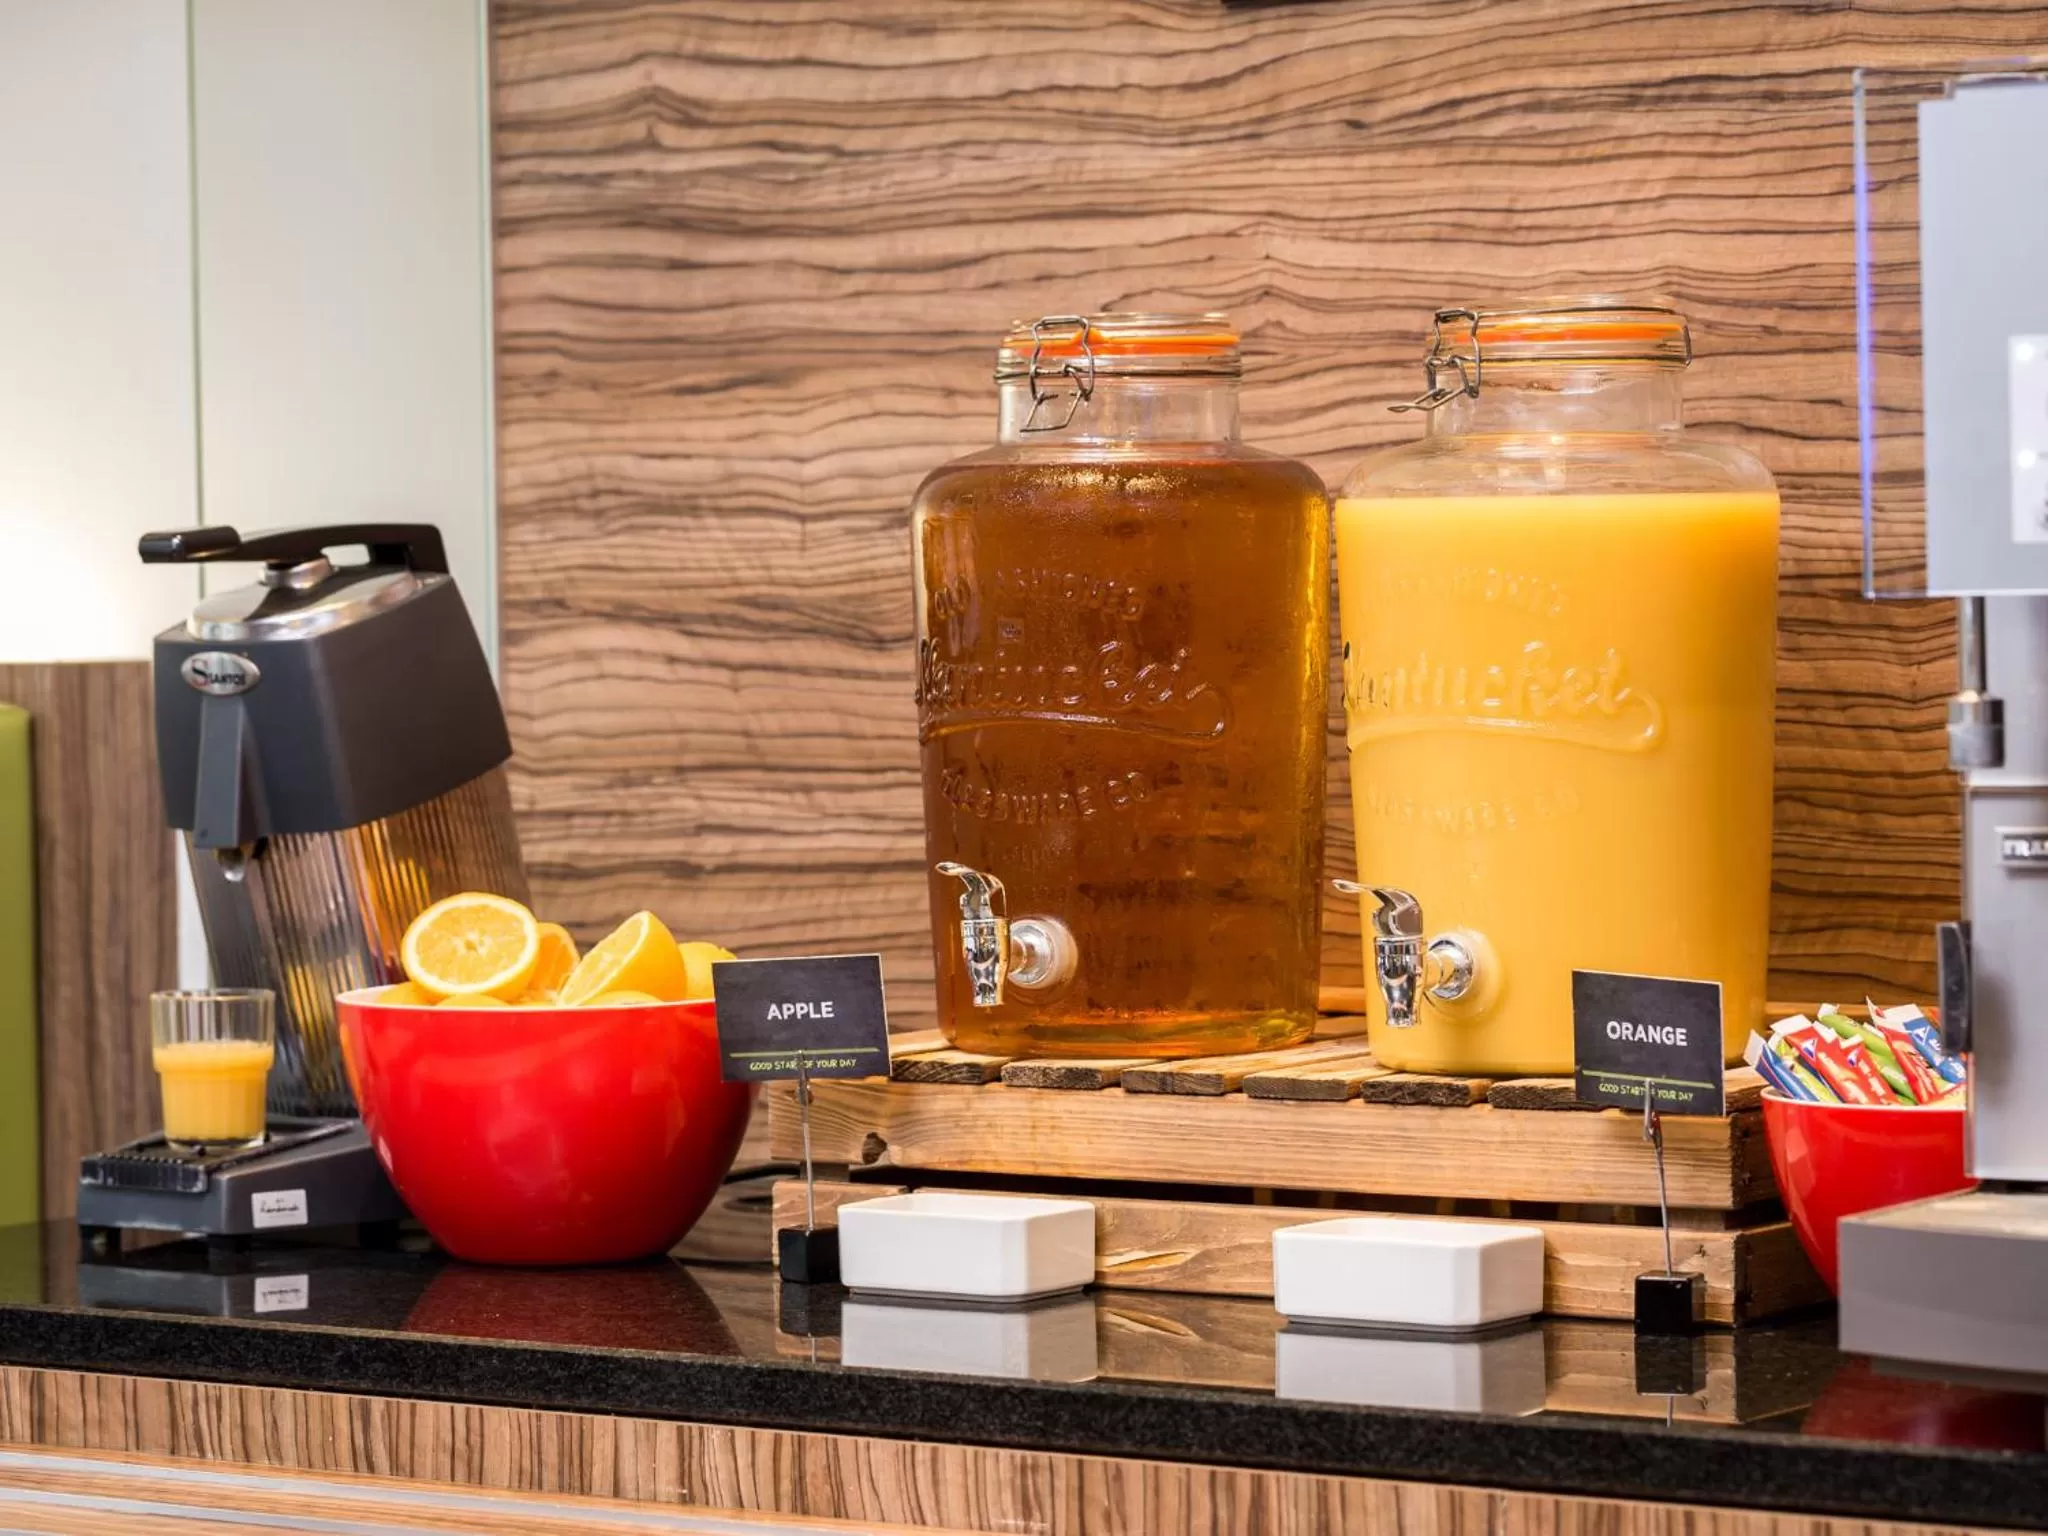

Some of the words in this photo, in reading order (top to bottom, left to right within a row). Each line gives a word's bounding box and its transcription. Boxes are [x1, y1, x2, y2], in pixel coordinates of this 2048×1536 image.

[766, 1001, 835, 1020] APPLE
[1606, 1020, 1688, 1046] ORANGE
[750, 1061, 773, 1071] GOOD
[774, 1060, 800, 1070] STAR
[816, 1059, 838, 1068] YOUR
[839, 1058, 857, 1067] DAY
[1599, 1083, 1619, 1093] GOOD
[1657, 1089, 1677, 1100] YOUR
[1678, 1092, 1694, 1101] DAY
